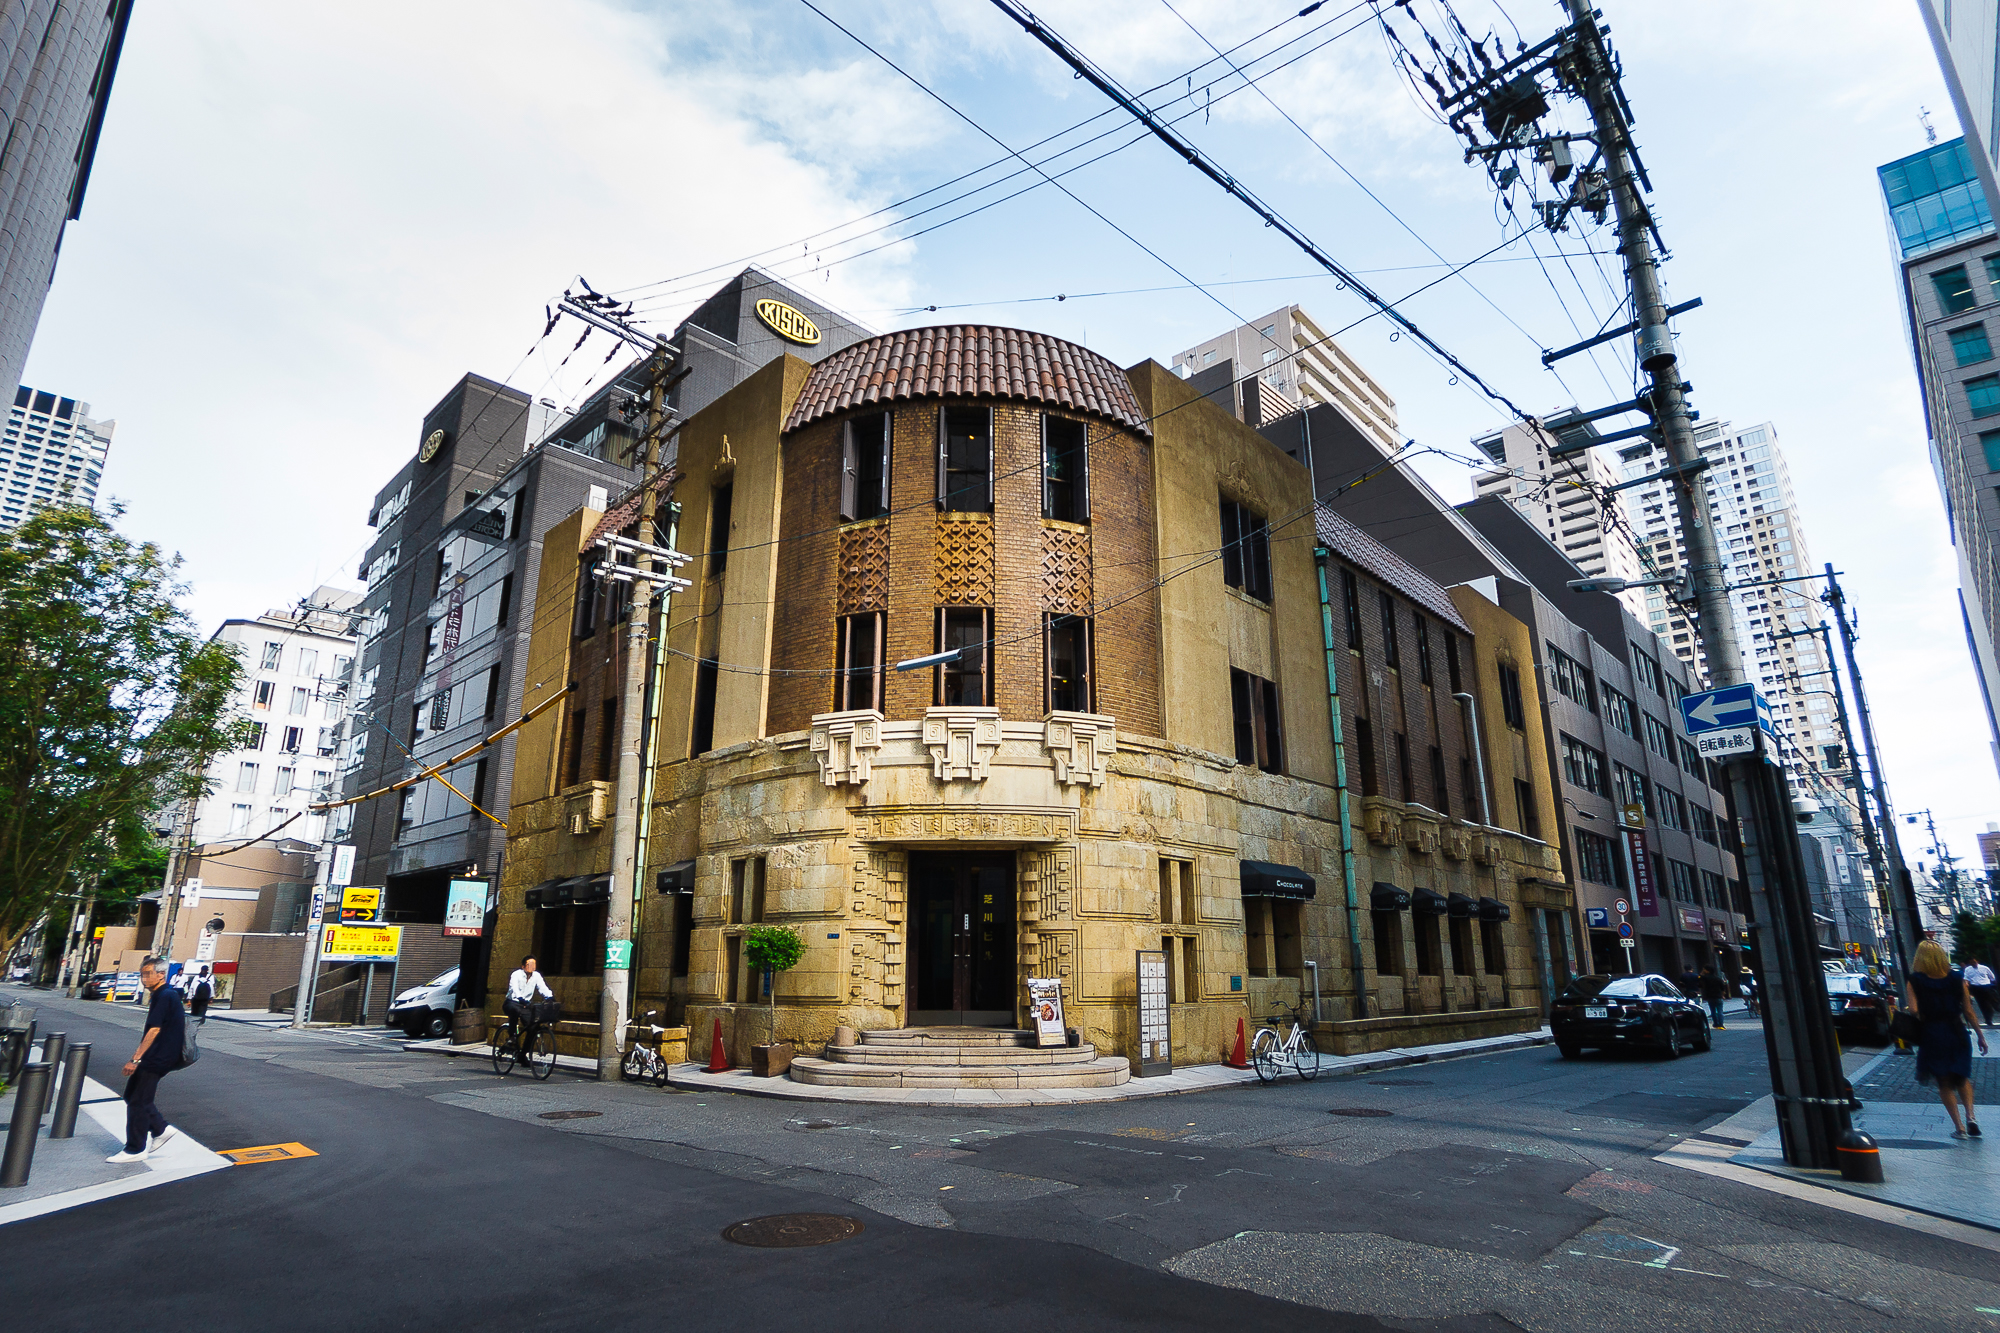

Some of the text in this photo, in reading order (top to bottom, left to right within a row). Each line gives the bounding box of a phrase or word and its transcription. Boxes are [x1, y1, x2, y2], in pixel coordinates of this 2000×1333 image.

[763, 302, 815, 340] KISCO
[1700, 734, 1752, 752] 自転車を除く
[350, 894, 375, 903] Times
[1617, 902, 1627, 911] 30
[1588, 910, 1605, 926] P
[449, 928, 478, 936] NIKKA
